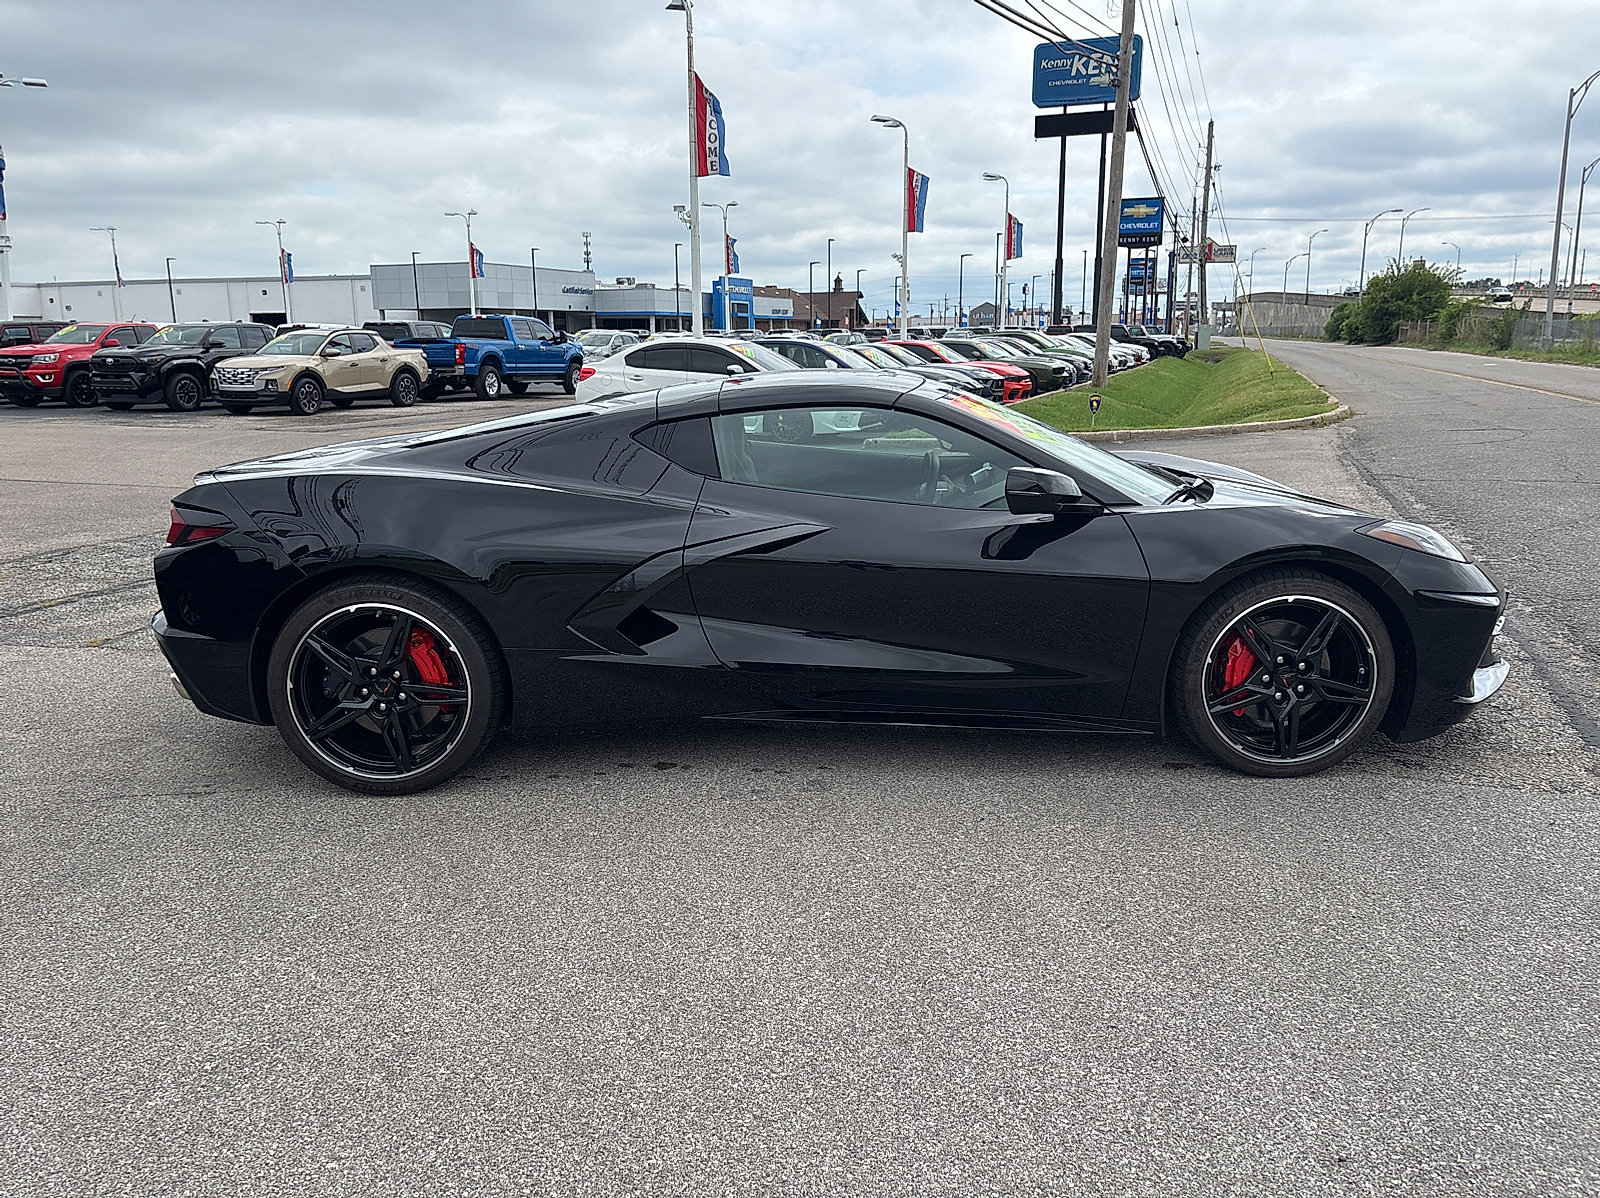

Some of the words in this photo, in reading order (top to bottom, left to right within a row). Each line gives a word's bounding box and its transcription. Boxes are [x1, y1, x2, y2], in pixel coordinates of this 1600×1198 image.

[1040, 58, 1073, 70] Kenny
[1048, 78, 1087, 87] CHEVROLET
[1120, 222, 1158, 230] CHEVROLET
